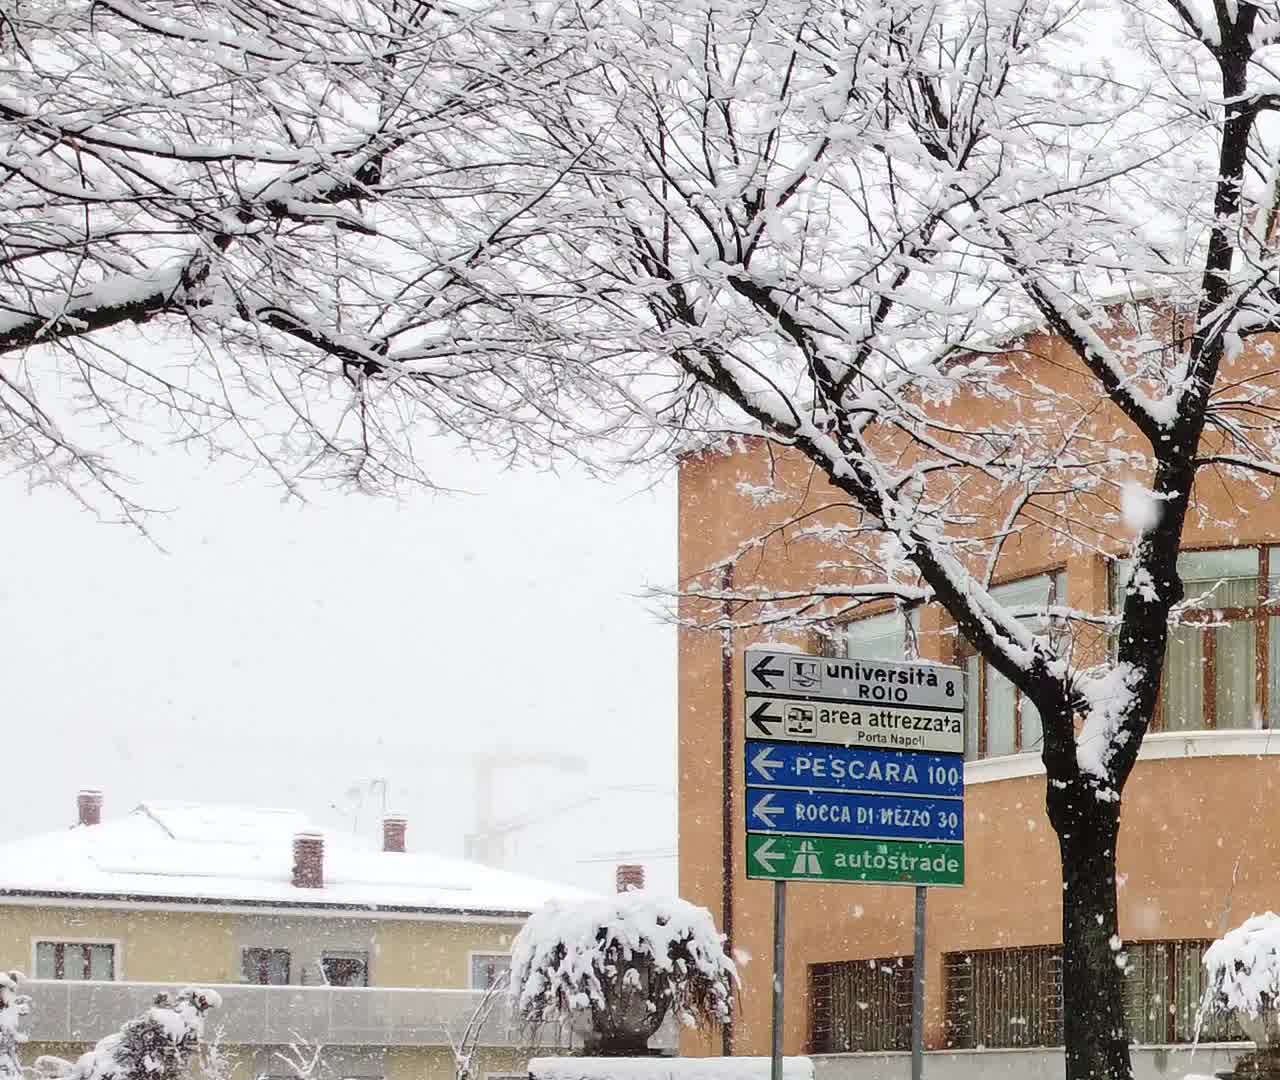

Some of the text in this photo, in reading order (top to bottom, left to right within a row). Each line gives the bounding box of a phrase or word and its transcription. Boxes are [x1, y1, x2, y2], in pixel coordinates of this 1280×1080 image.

[827, 662, 955, 697] università 8
[859, 684, 908, 702] ROIO
[820, 708, 962, 734] area attrezzata
[857, 731, 925, 747] Porta Napoli
[796, 757, 959, 786] PESCARA 100
[795, 803, 959, 829] ROCCA DI MEZZO 30
[834, 850, 960, 874] autostrade
